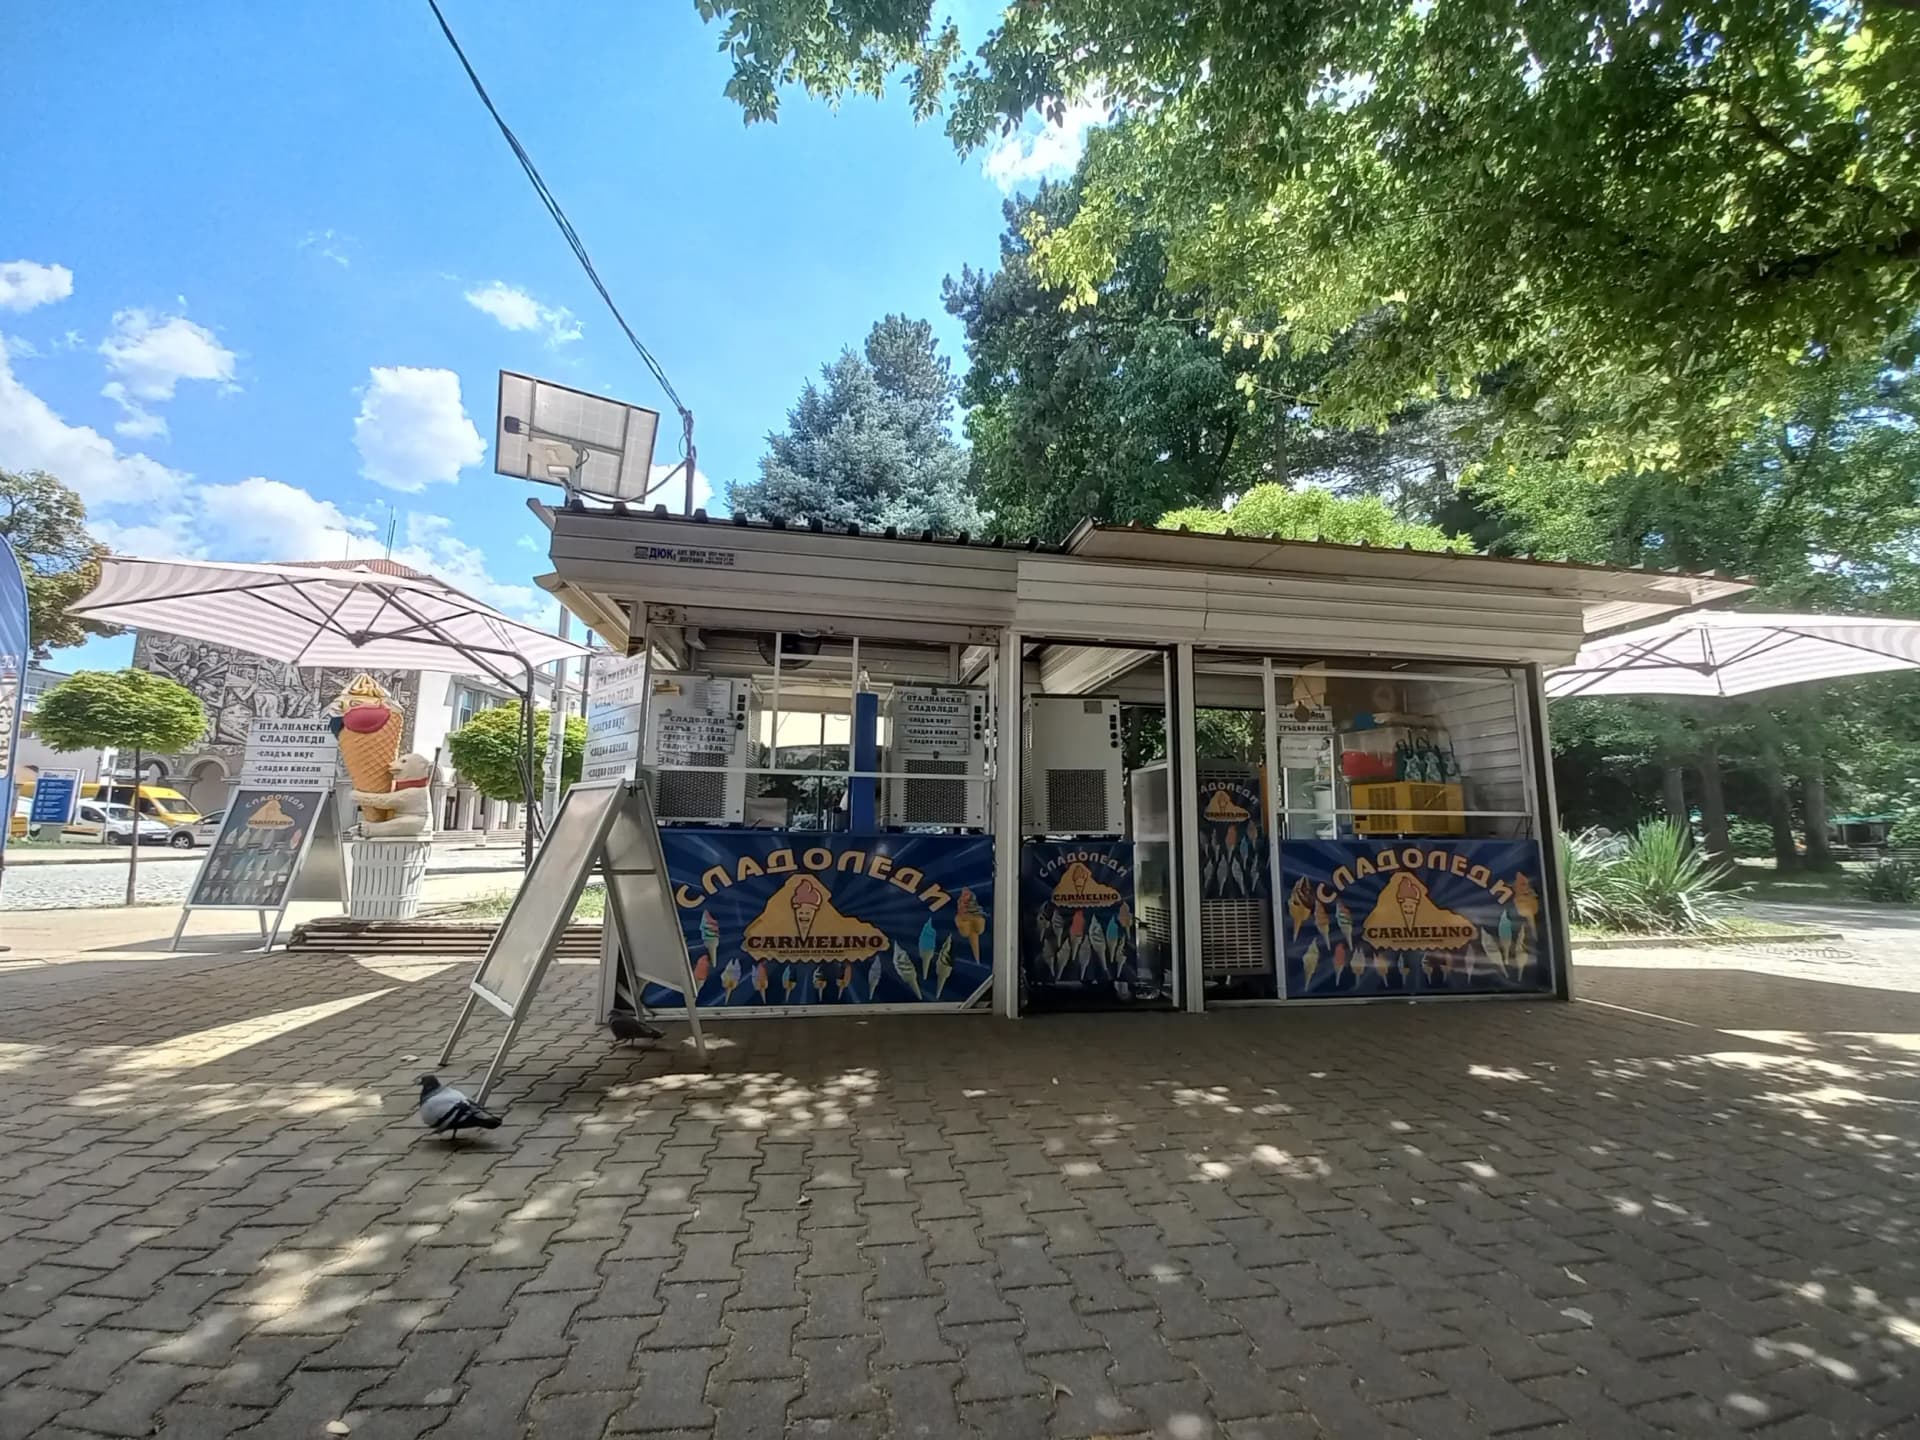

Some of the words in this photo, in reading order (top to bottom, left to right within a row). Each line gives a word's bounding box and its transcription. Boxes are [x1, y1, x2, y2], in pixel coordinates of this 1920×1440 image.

[907, 695, 962, 703] ИТАЛИАНСКИ
[908, 705, 959, 713] СЛАДОЛЕДИ
[260, 735, 326, 744] СЛАДОЛЕДИ
[294, 751, 315, 759] вкус
[1200, 782, 1258, 805] АДОЛЕДИ
[1039, 851, 1128, 877] СЛАДОЛЕДИ
[675, 847, 952, 912] СЛАДОЛЕДИ
[1316, 848, 1514, 905] СЛАДОЛЕДИ
[1054, 893, 1118, 901] CARMELINO
[1367, 926, 1472, 939] CARMELINO
[747, 935, 883, 949] CARMELINO
